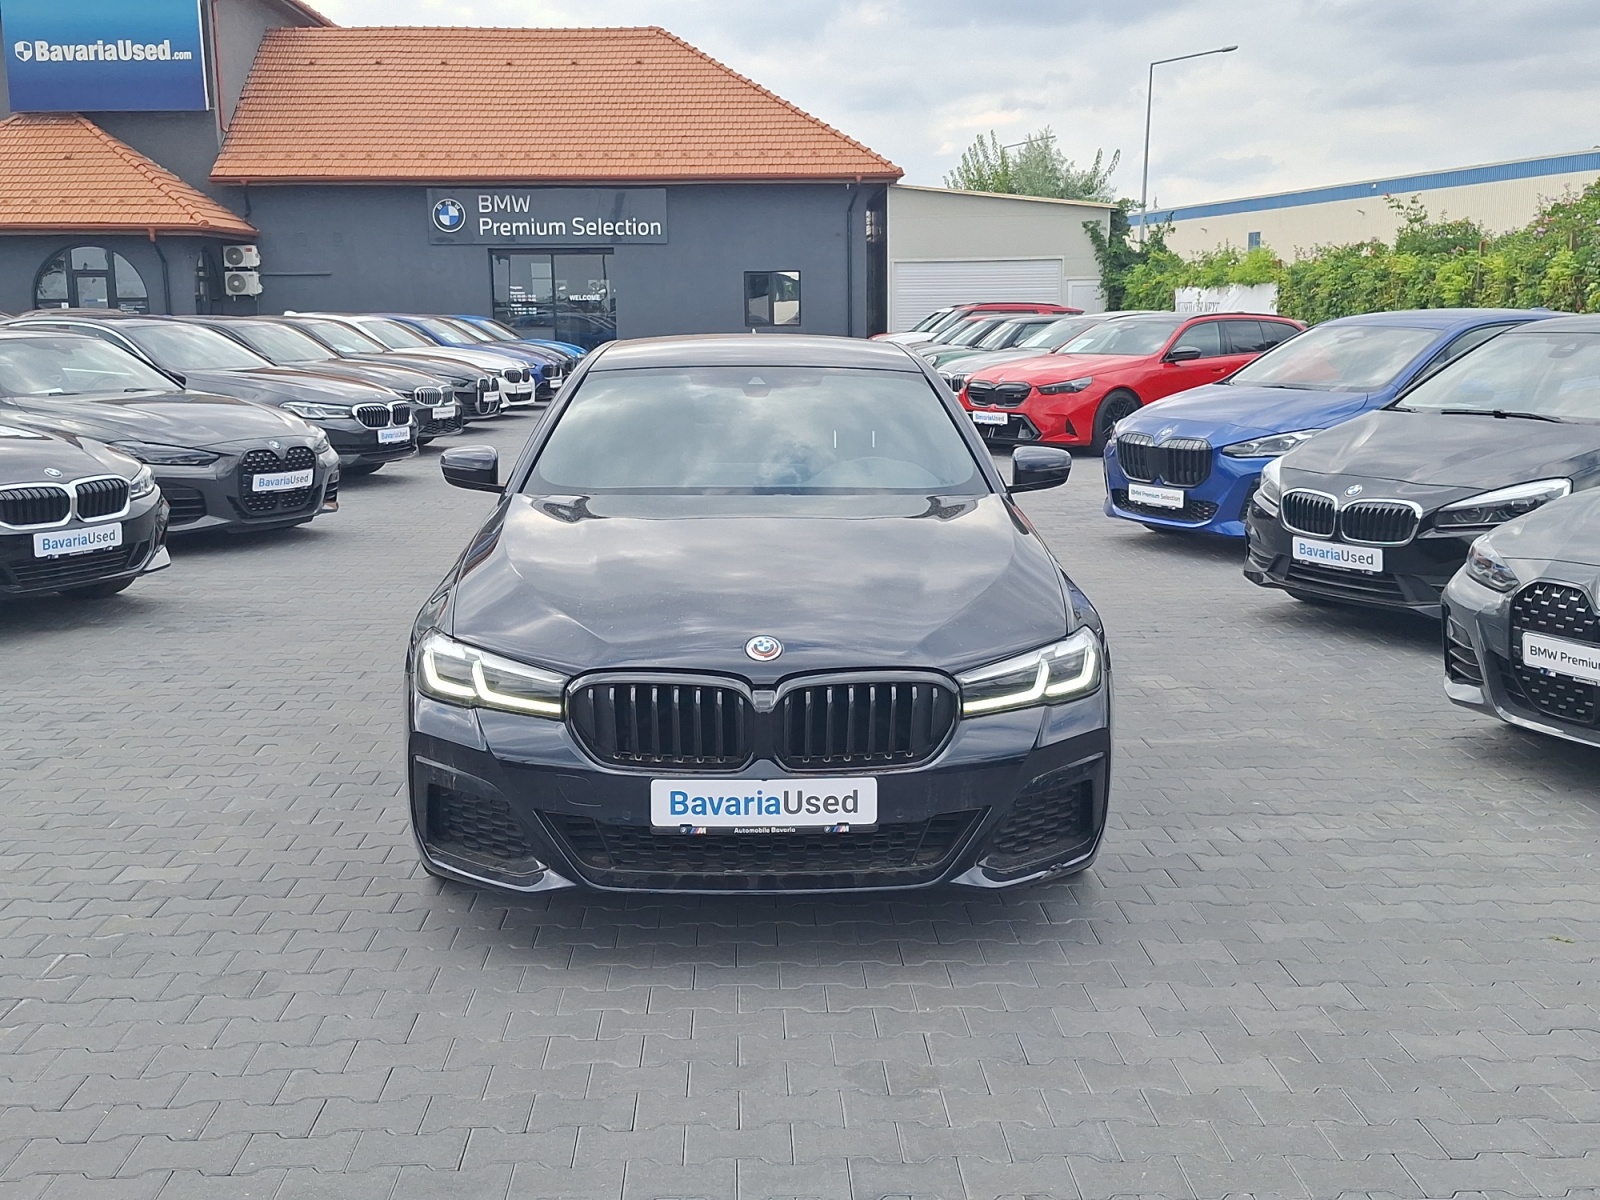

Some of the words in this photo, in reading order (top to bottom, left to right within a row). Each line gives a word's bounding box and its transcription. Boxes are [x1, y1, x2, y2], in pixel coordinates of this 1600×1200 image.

[34, 40, 192, 62] BavariaUsed.com
[478, 195, 531, 213] BMW
[479, 217, 566, 236] Premium
[571, 217, 662, 236] Selection
[258, 473, 309, 487] BavariaUsed
[42, 529, 116, 551] BavariaUsed
[1299, 542, 1374, 566] BavariaUsed
[1530, 645, 1558, 661] BMW
[1560, 651, 1600, 671] Premiu
[669, 789, 859, 817] BavariaUsed
[734, 826, 770, 835] Automobile
[771, 826, 796, 834] Bavaria
